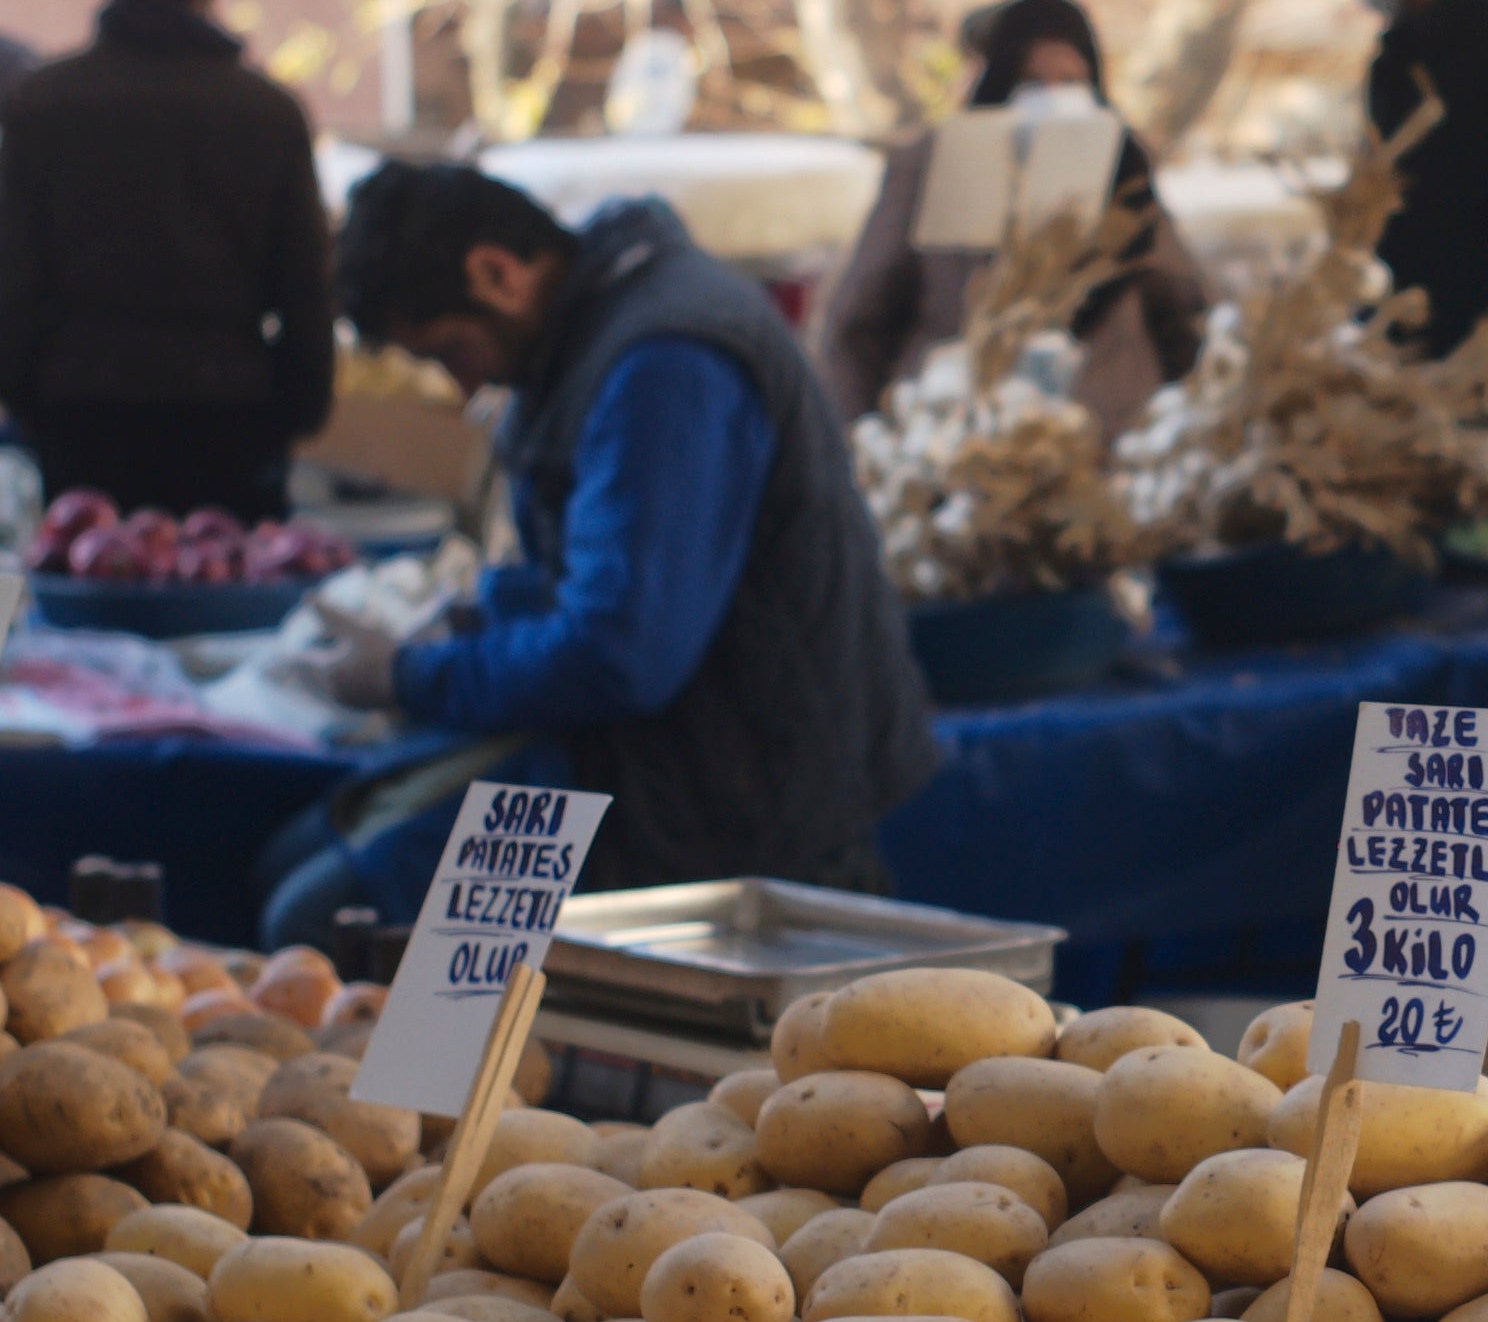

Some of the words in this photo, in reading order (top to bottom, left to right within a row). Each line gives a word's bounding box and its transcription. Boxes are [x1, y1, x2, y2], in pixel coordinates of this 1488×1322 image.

[1386, 708, 1478, 746] TAZE
[1404, 753, 1484, 790] SARI
[484, 788, 567, 836] SARI
[457, 835, 573, 878] PATATES
[1390, 882, 1480, 924] OLUR
[1344, 898, 1377, 975] 3
